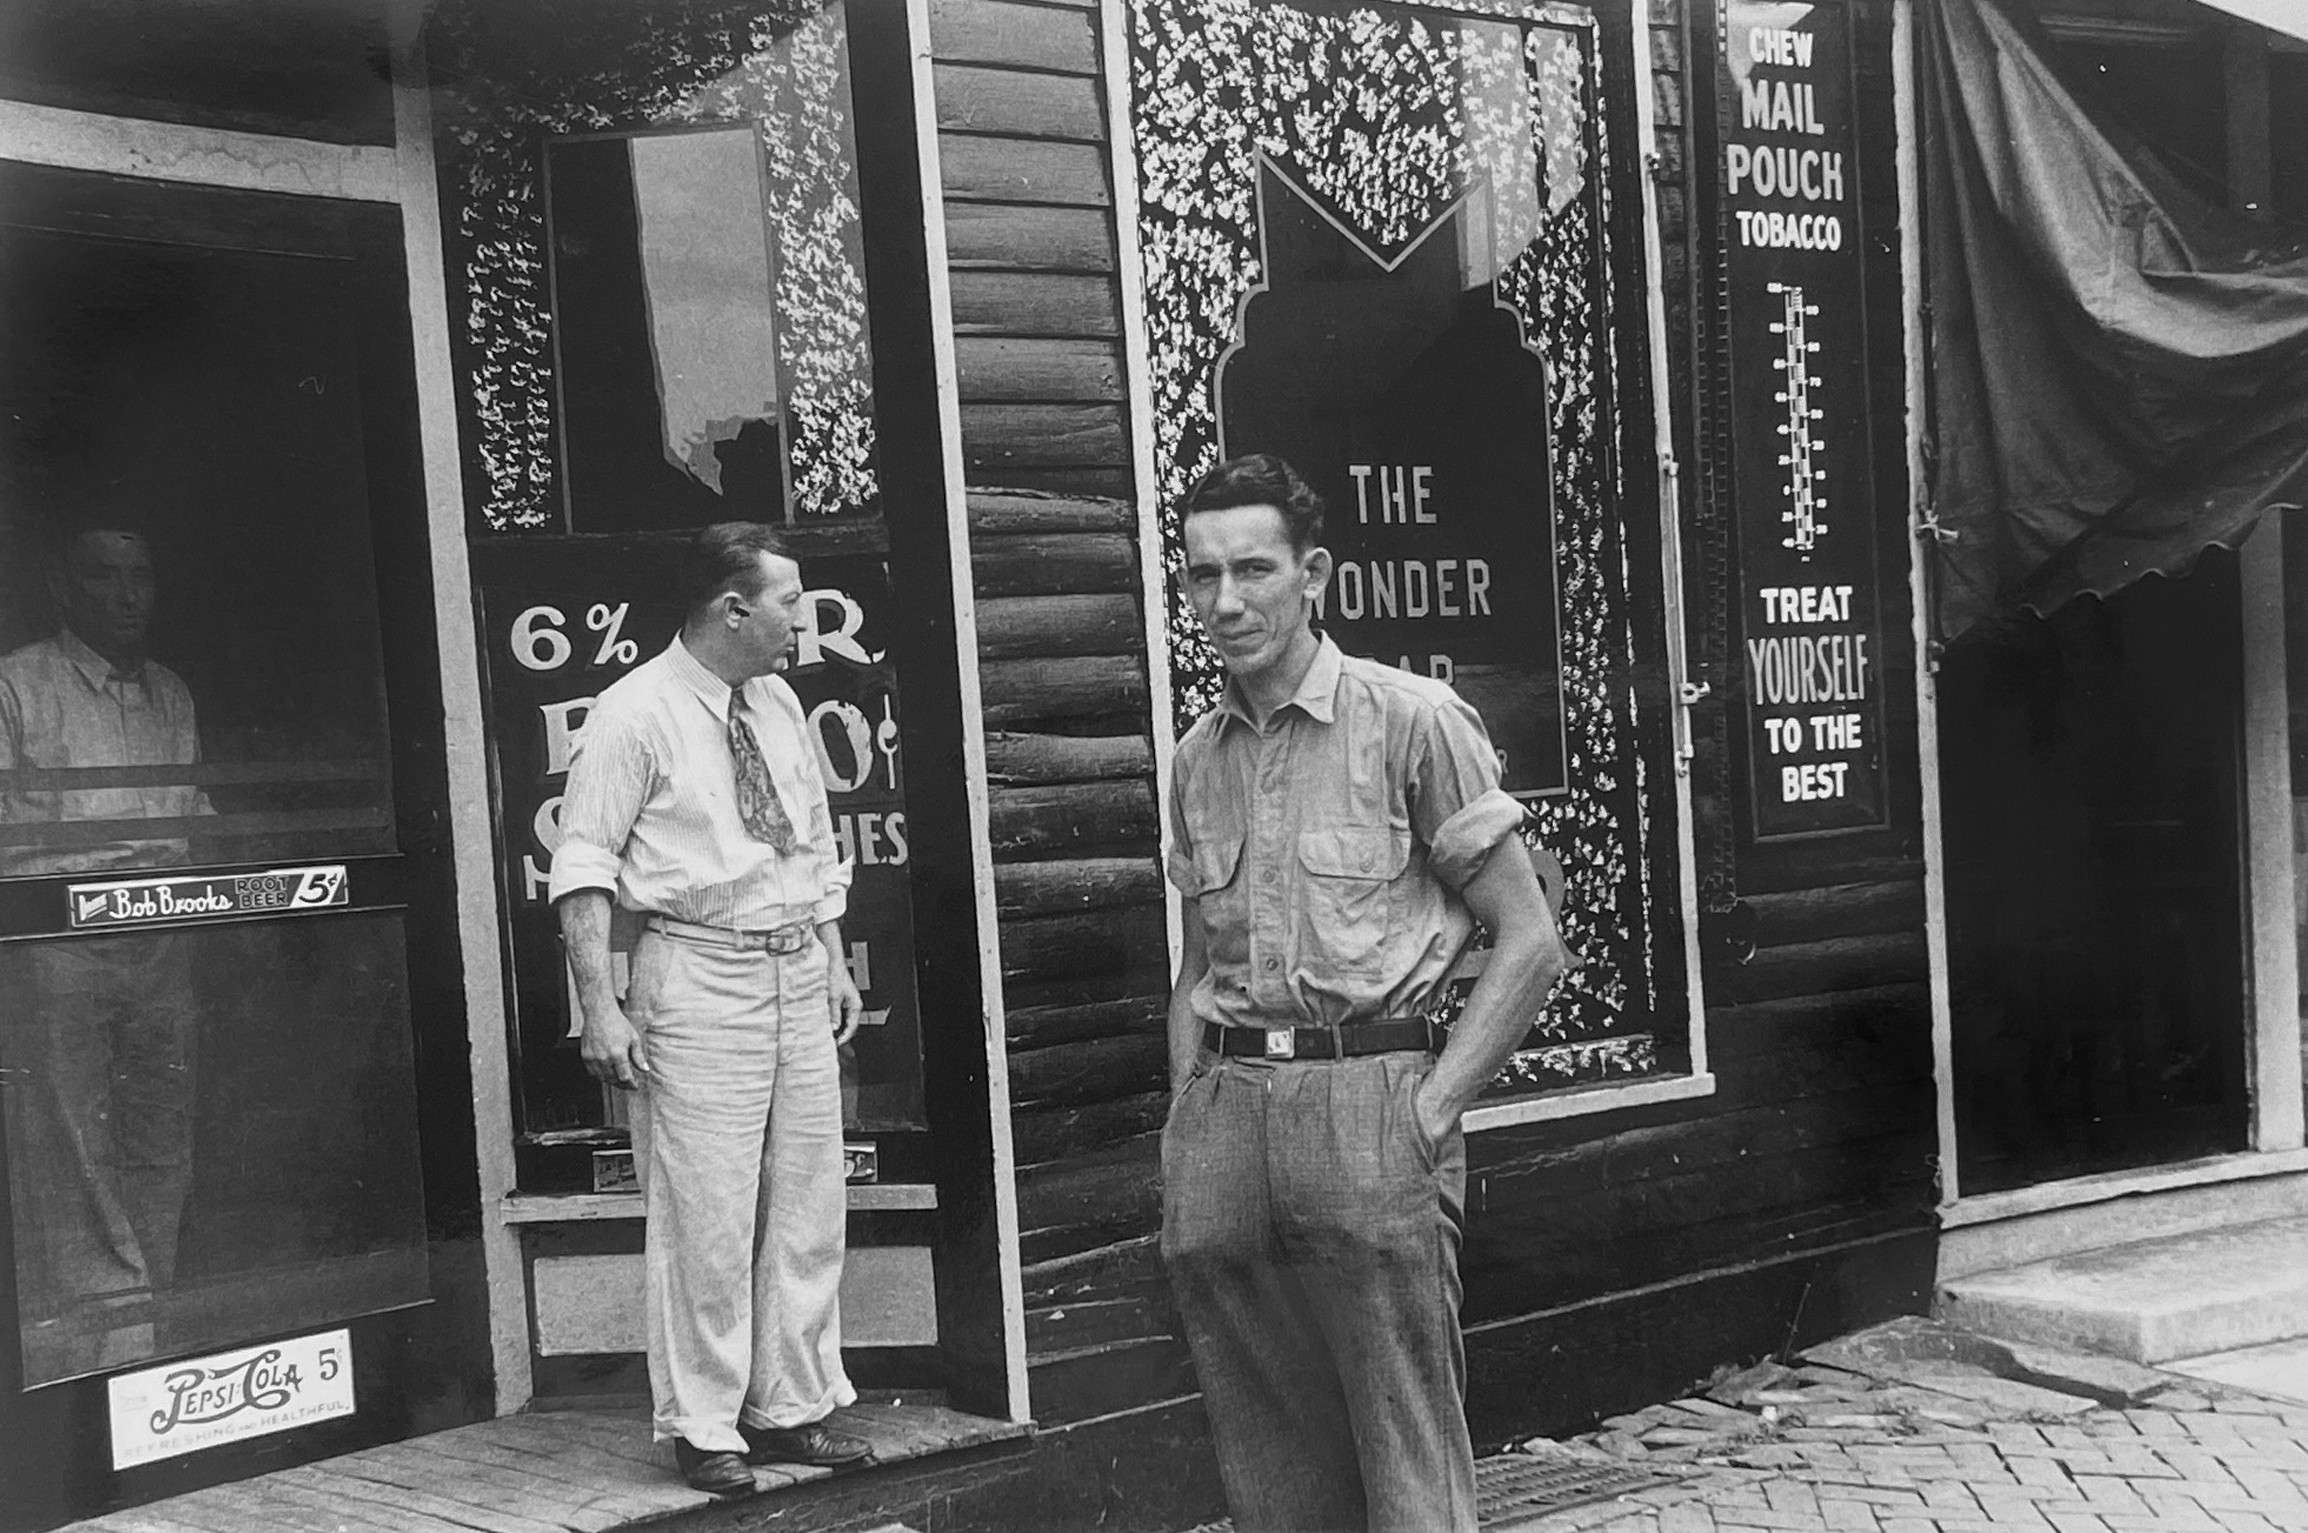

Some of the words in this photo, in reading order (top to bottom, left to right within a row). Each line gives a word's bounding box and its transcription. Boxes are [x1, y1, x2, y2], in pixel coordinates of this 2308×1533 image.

[1750, 27, 1813, 67] CHEW
[1742, 78, 1824, 135] MAIL
[1727, 144, 1844, 201] POUCH
[1735, 211, 1841, 251] TOBACCO
[1349, 465, 1437, 524] THE
[1760, 586, 1853, 623] TREAT
[1748, 634, 1867, 705] YOURSELF
[1764, 718, 1802, 754] TO
[1810, 714, 1862, 750] THE
[1782, 762, 1848, 802] BEST
[109, 888, 156, 919] Bob
[156, 884, 233, 915] Brooks
[234, 875, 289, 894] ROOT
[238, 891, 289, 909] BEER
